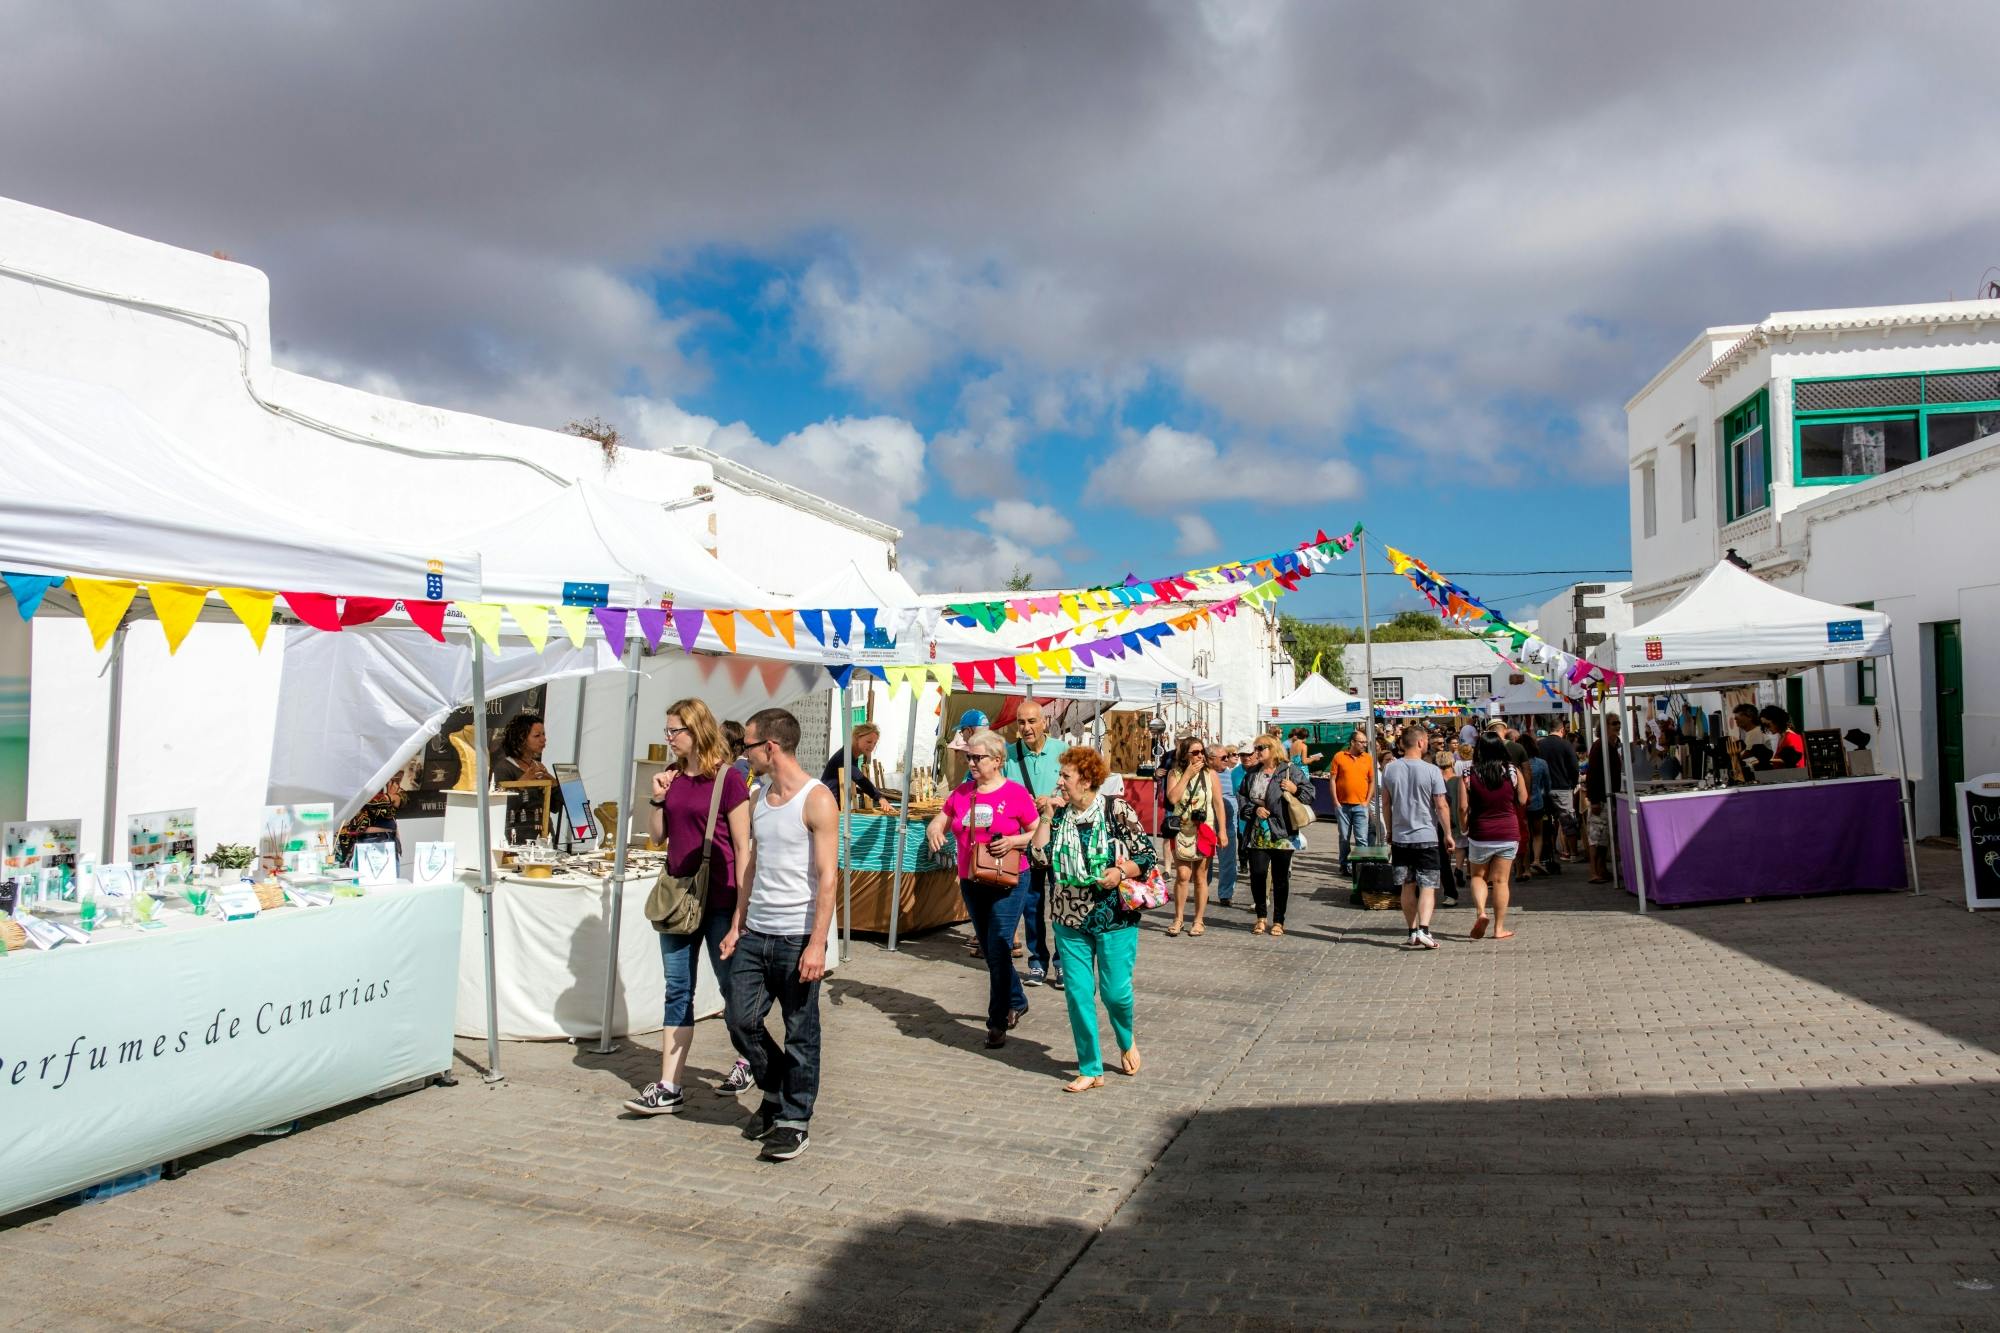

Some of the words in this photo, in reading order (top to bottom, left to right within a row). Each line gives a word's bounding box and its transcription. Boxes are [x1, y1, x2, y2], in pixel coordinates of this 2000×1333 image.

[0, 1030, 189, 1090] erfumes
[205, 1007, 241, 1045] de
[256, 978, 390, 1035] Canarias
